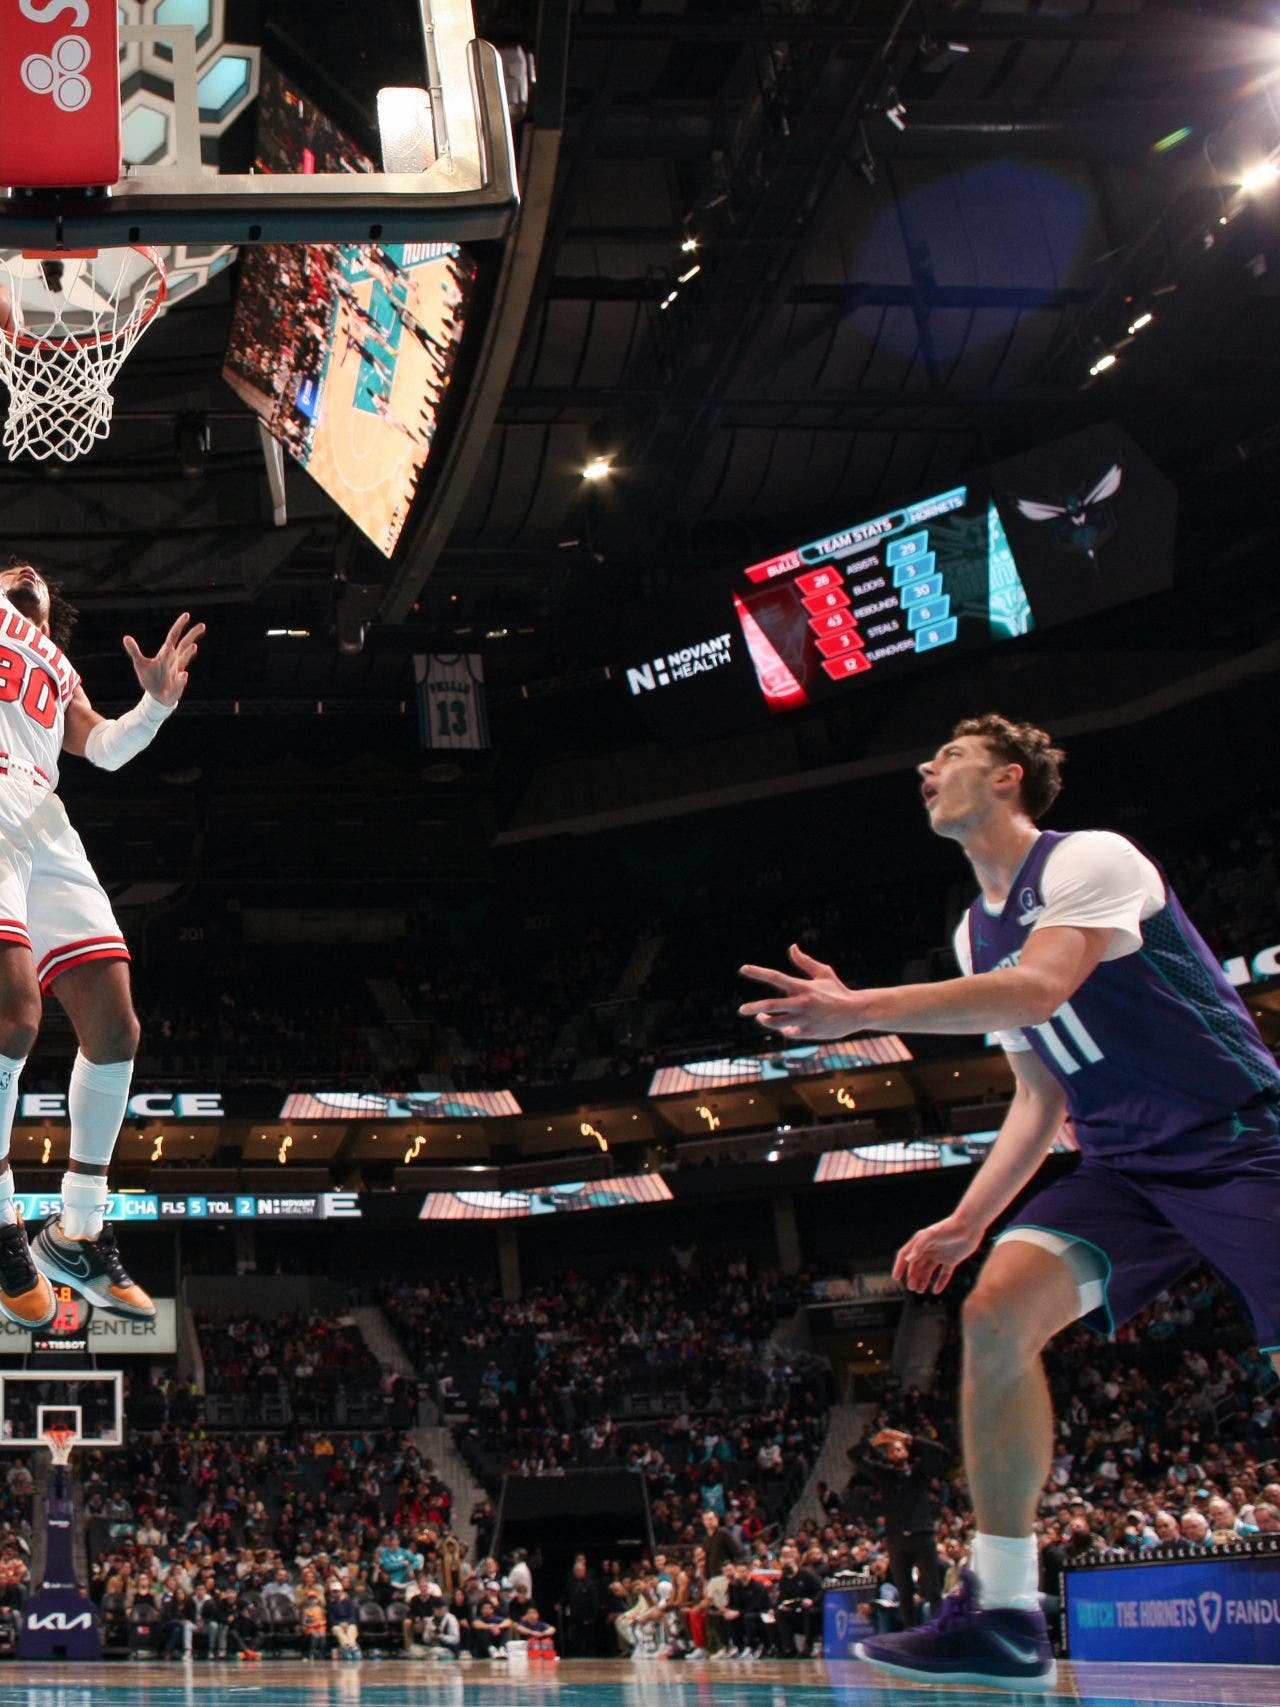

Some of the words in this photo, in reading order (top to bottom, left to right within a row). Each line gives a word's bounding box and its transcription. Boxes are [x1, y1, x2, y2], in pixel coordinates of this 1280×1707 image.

[911, 496, 964, 522] HORNETS
[817, 532, 852, 555] TEAM
[854, 518, 893, 543] STATS
[767, 557, 800, 578] BULLS
[846, 555, 880, 575] ASSISTS
[852, 577, 886, 596] BLOCKS
[853, 596, 899, 619] REBOUNDS
[867, 619, 900, 638] STEALS
[667, 633, 731, 667] NOVANT
[672, 649, 732, 681] HEALTH
[436, 699, 467, 736] 13
[1032, 1001, 1105, 1076] 11
[125, 1202, 157, 1215] CHA
[162, 1202, 185, 1214] FLS
[190, 1201, 202, 1214] 5
[208, 1202, 234, 1214] TOL
[239, 1201, 251, 1214] 2
[281, 1200, 316, 1208] NOVANT
[88, 1318, 157, 1336] ENTER
[48, 1341, 86, 1349] TISSOT
[1115, 1601, 1139, 1628] THE
[1140, 1600, 1198, 1628] HORNETS
